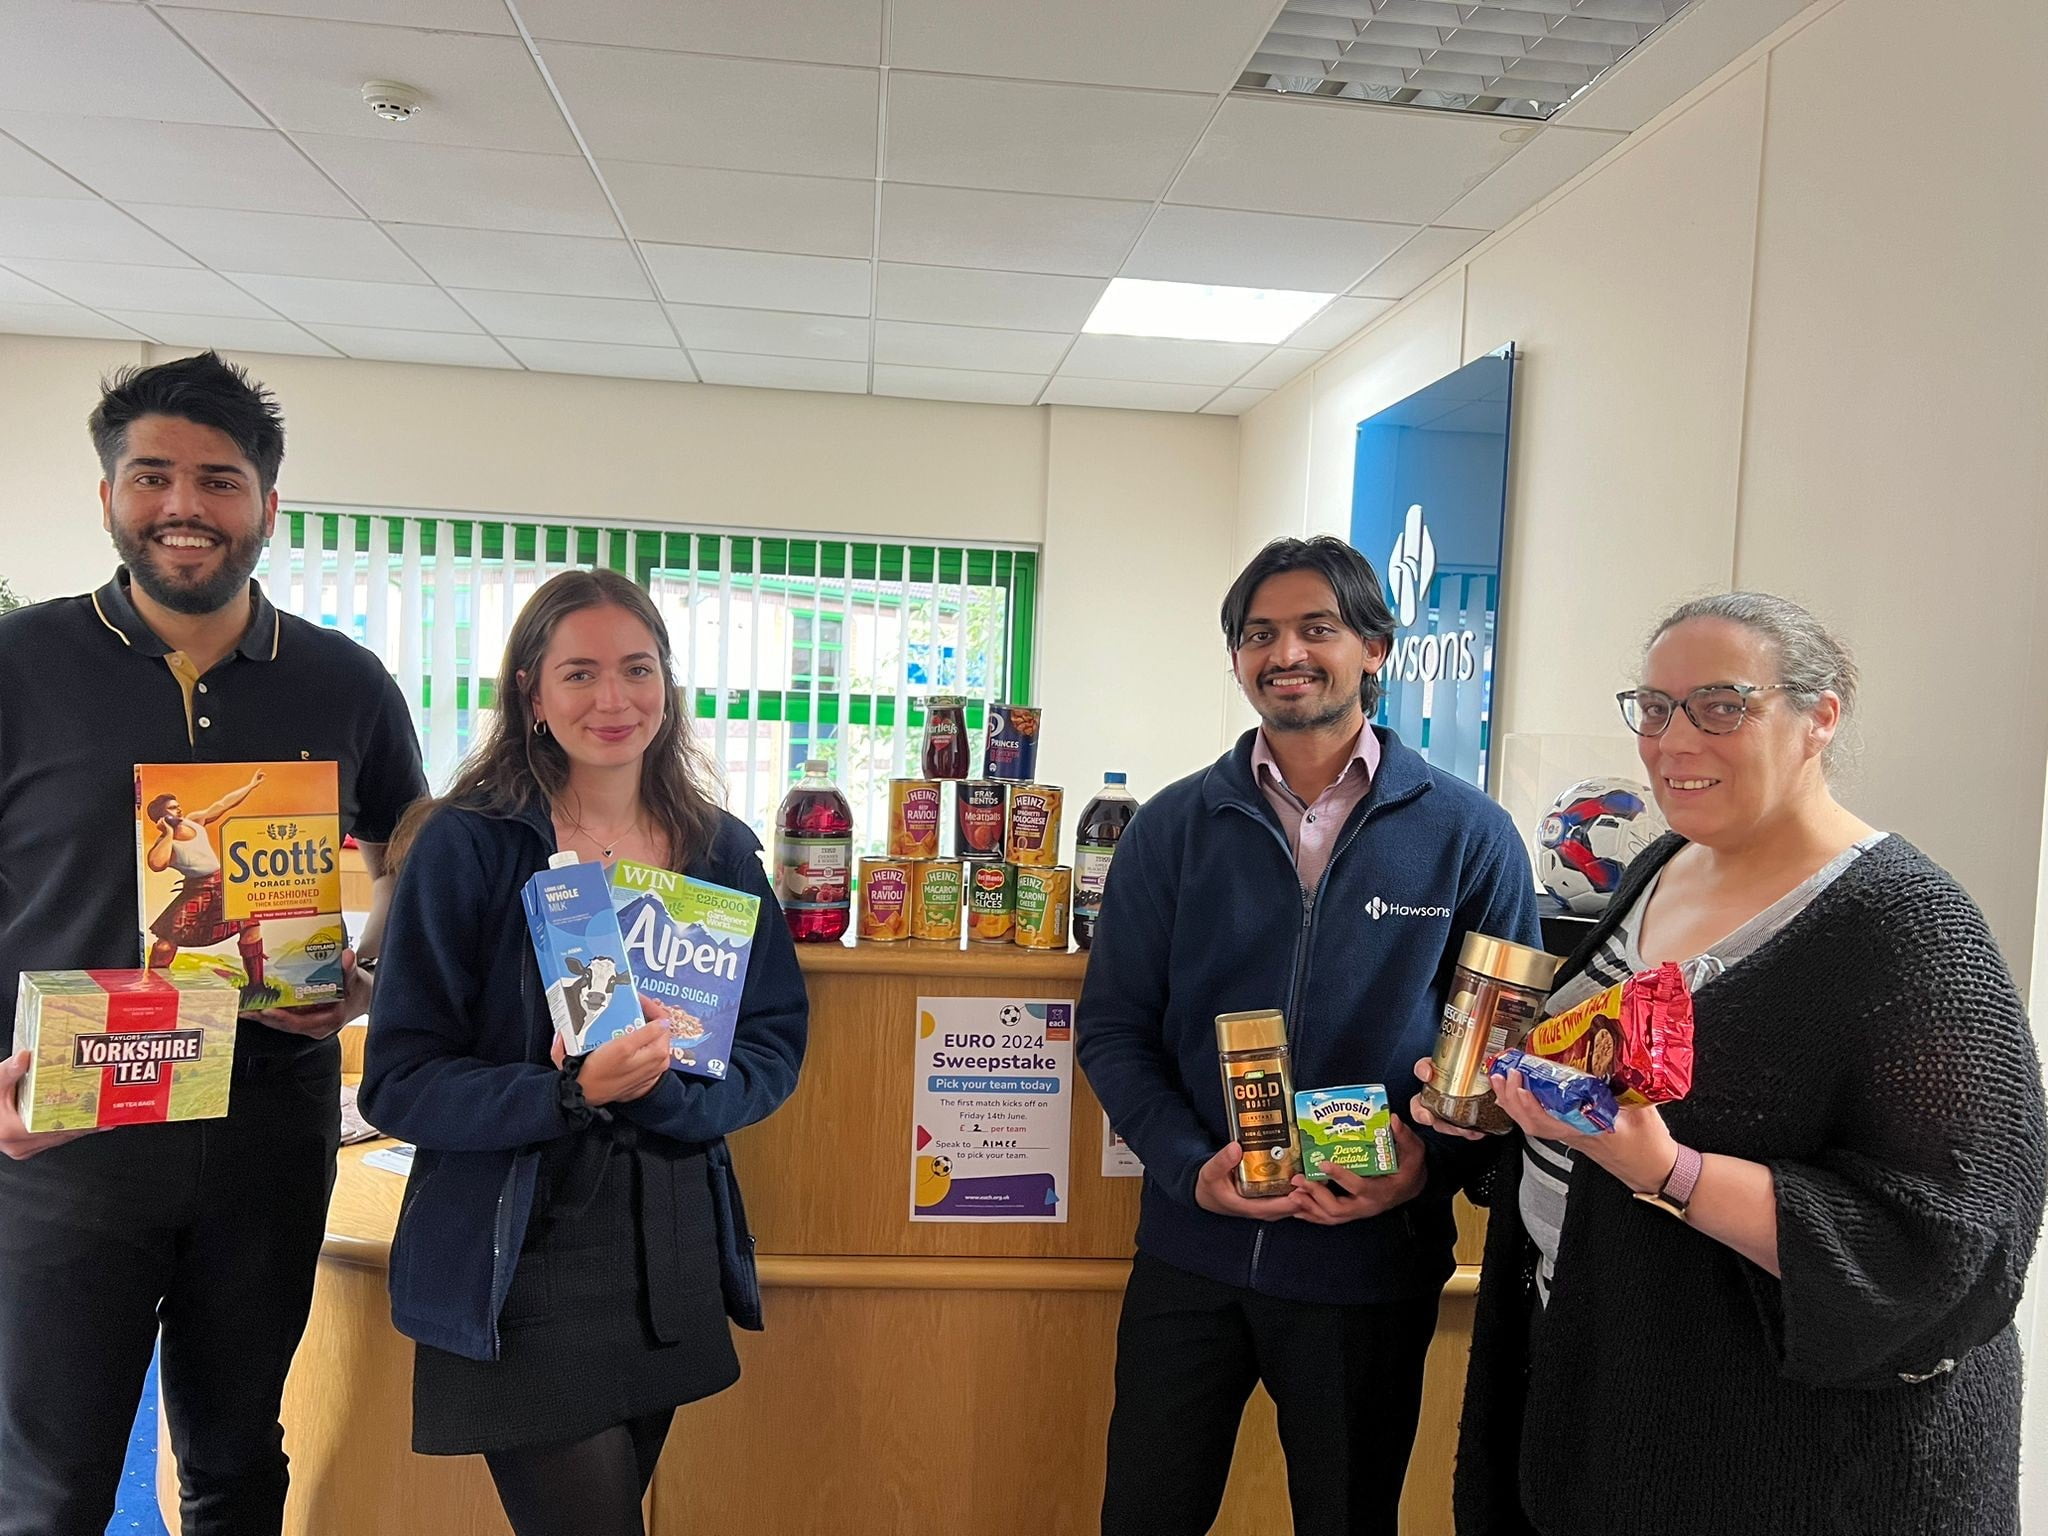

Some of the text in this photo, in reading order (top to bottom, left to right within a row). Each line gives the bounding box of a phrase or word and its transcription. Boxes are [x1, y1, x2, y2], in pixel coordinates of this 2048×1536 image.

[1377, 630, 1475, 682] wsons
[991, 738, 1020, 748] PRINCES
[910, 790, 937, 802] HEINZ
[969, 797, 998, 805] BENTOS
[1016, 796, 1044, 808] HEINZ
[908, 810, 937, 820] RAVIOLI
[964, 812, 1000, 822] Meatballs
[1012, 814, 1046, 826] BOLOGNESE
[229, 836, 334, 884] Scott's
[622, 865, 678, 892] WIN
[874, 871, 903, 882] HEINZ
[928, 872, 956, 882] HEINZ
[254, 878, 316, 888] PORAGE OATS
[247, 888, 320, 902] OLD FASHIONED
[545, 888, 580, 902] WHOLE
[871, 890, 903, 900] RAVIOLI
[975, 892, 1002, 901] PEACH
[696, 893, 745, 913] £25,000
[975, 900, 1002, 908] SLICES
[1390, 903, 1451, 918] Hawsons
[306, 943, 335, 952] SCOTLAND
[623, 903, 738, 980] Alpen
[640, 977, 680, 996] ADDED
[681, 986, 719, 1007] SUGAR
[1442, 1019, 1464, 1038] GOLD
[944, 1034, 996, 1048] EURO
[1001, 1035, 1044, 1049] 2024
[80, 1038, 198, 1064] YORKSHIRE
[710, 1060, 721, 1070] 12
[932, 1052, 1056, 1072] Sweepstake
[118, 1060, 156, 1082] TEA
[936, 1078, 1052, 1092] Pick your team today
[1234, 1082, 1280, 1100] GOLD
[940, 1098, 956, 1106] The
[1245, 1099, 1272, 1109] ROAST
[960, 1112, 984, 1120] Friday
[1313, 1101, 1371, 1121] Ambrosia
[973, 1124, 982, 1132] 2
[936, 1140, 962, 1149] Speak
[1333, 1144, 1364, 1155] Devon
[968, 1152, 983, 1160] pick
[1330, 1152, 1370, 1164] Custard
